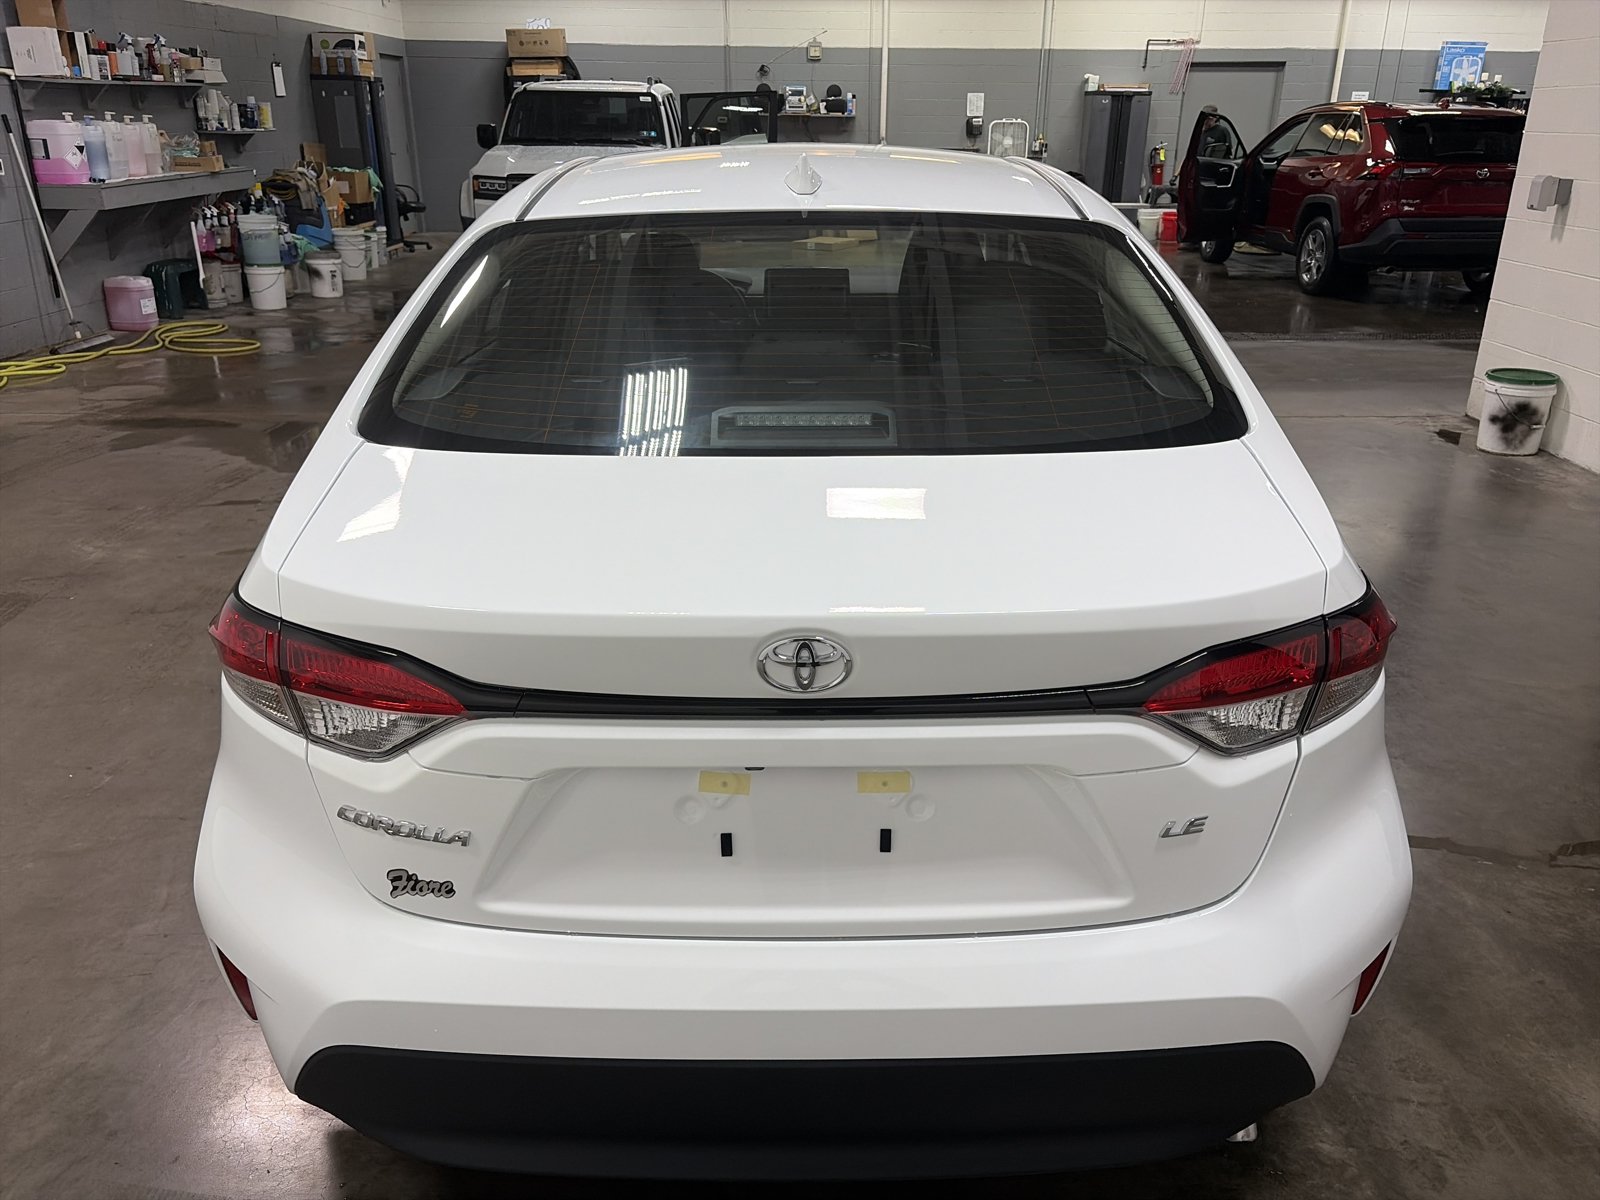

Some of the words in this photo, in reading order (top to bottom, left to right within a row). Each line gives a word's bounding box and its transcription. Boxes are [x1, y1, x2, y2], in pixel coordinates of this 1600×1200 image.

[336, 804, 472, 848] COROLLA
[1159, 815, 1209, 838] LE
[386, 868, 457, 899] Fiore
